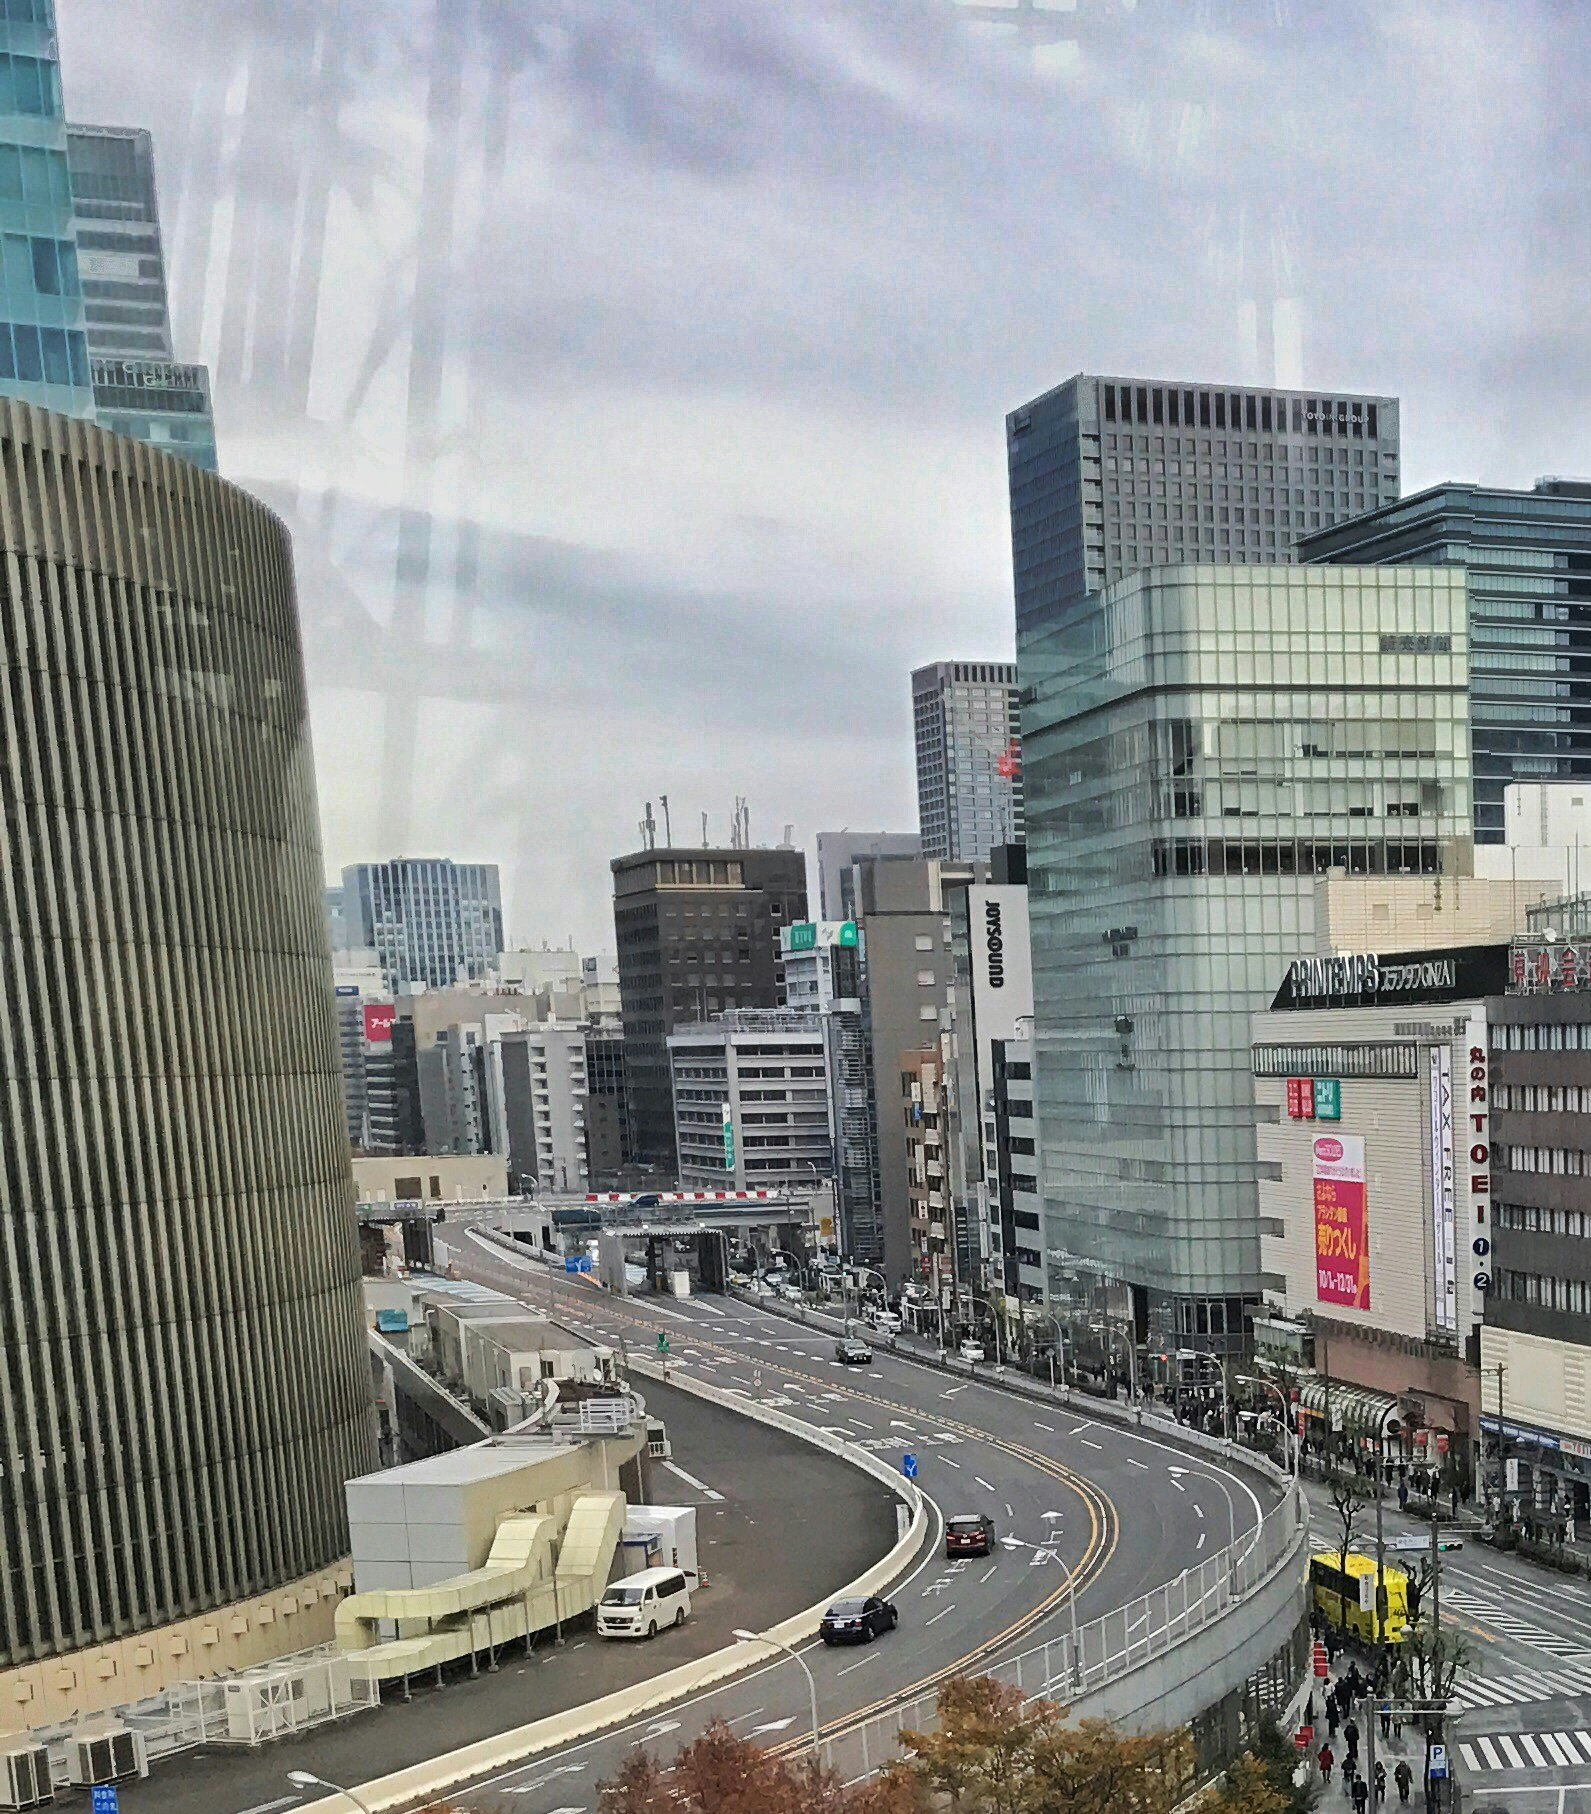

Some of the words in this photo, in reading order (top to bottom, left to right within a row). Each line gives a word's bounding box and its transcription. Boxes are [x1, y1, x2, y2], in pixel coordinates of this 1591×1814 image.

[1291, 953, 1380, 998] PRINTEMPS
[1470, 1046, 1485, 1103] 丸の内
[1470, 1114, 1489, 1224] TOEI
[1317, 1224, 1356, 1260] 売りつくし
[1433, 1746, 1443, 1759] P
